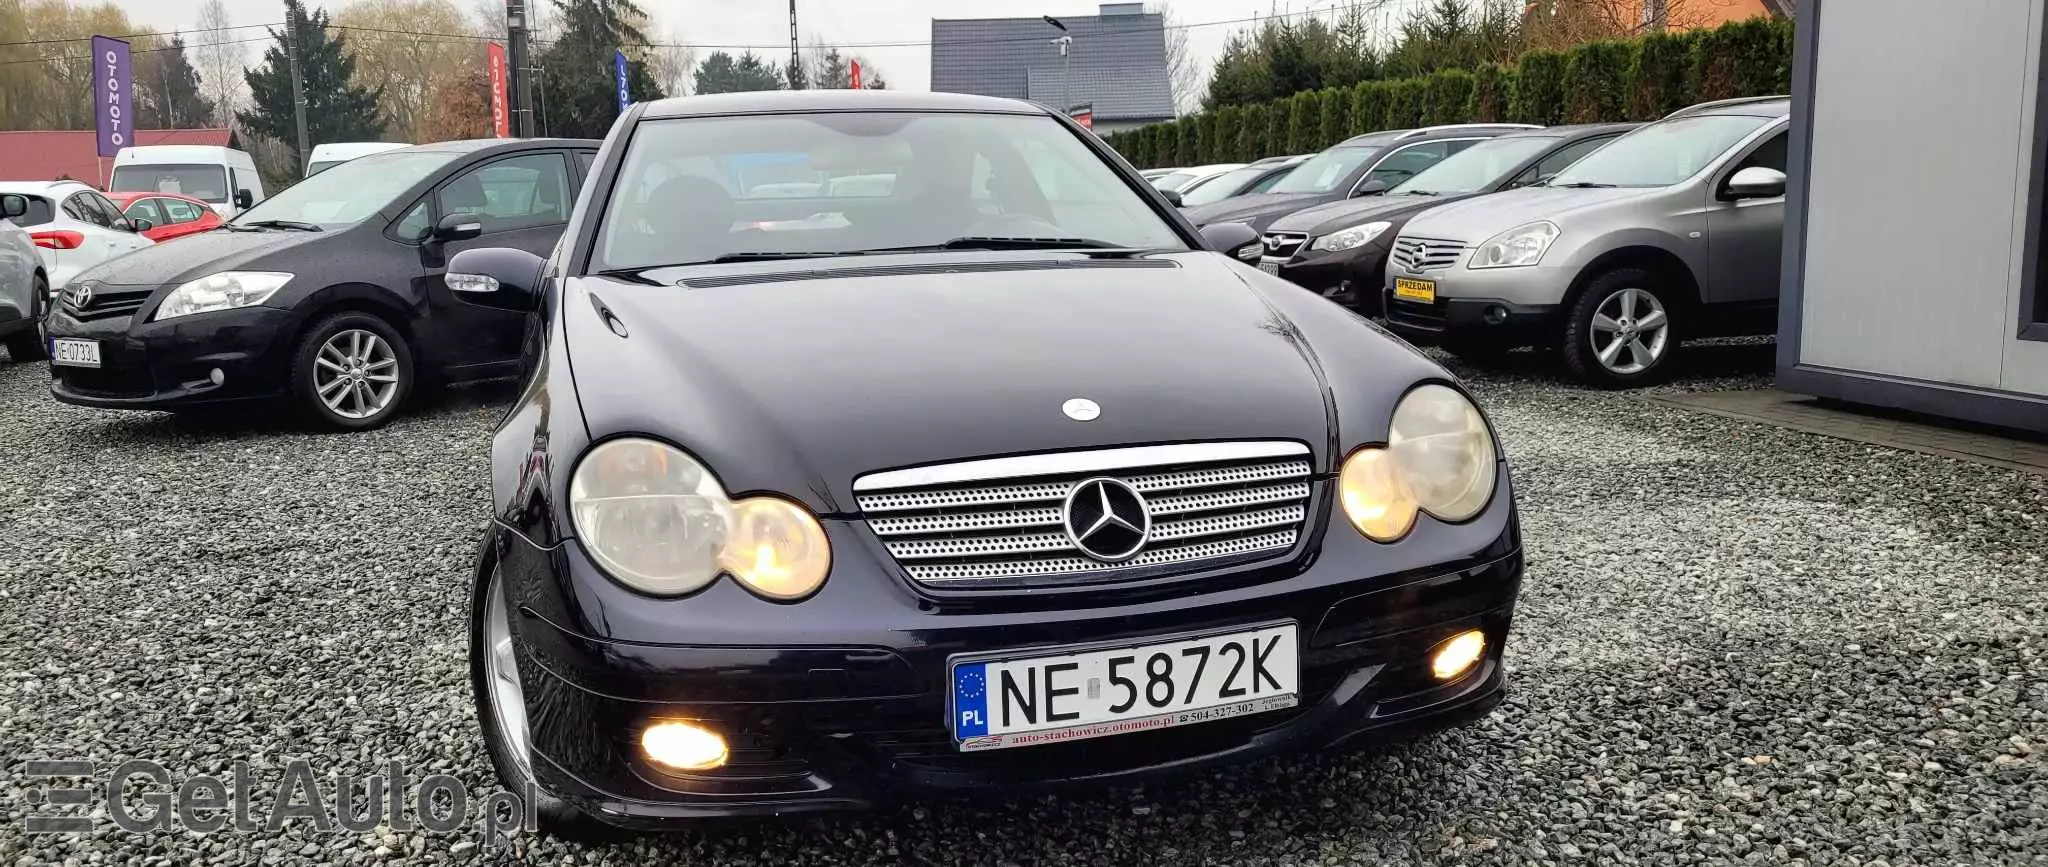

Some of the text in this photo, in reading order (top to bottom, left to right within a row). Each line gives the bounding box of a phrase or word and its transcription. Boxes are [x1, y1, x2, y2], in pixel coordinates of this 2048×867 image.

[106, 51, 123, 146] OTOMOTO
[493, 55, 503, 138] OTOMOT
[1397, 279, 1433, 292] SPRZEDAM
[55, 342, 98, 362] NE 0733L
[1001, 634, 1282, 727] NE 5872K
[962, 709, 984, 727] PL
[1012, 703, 1254, 744] auto-stachowicz.otomoto.pl 504-327-302
